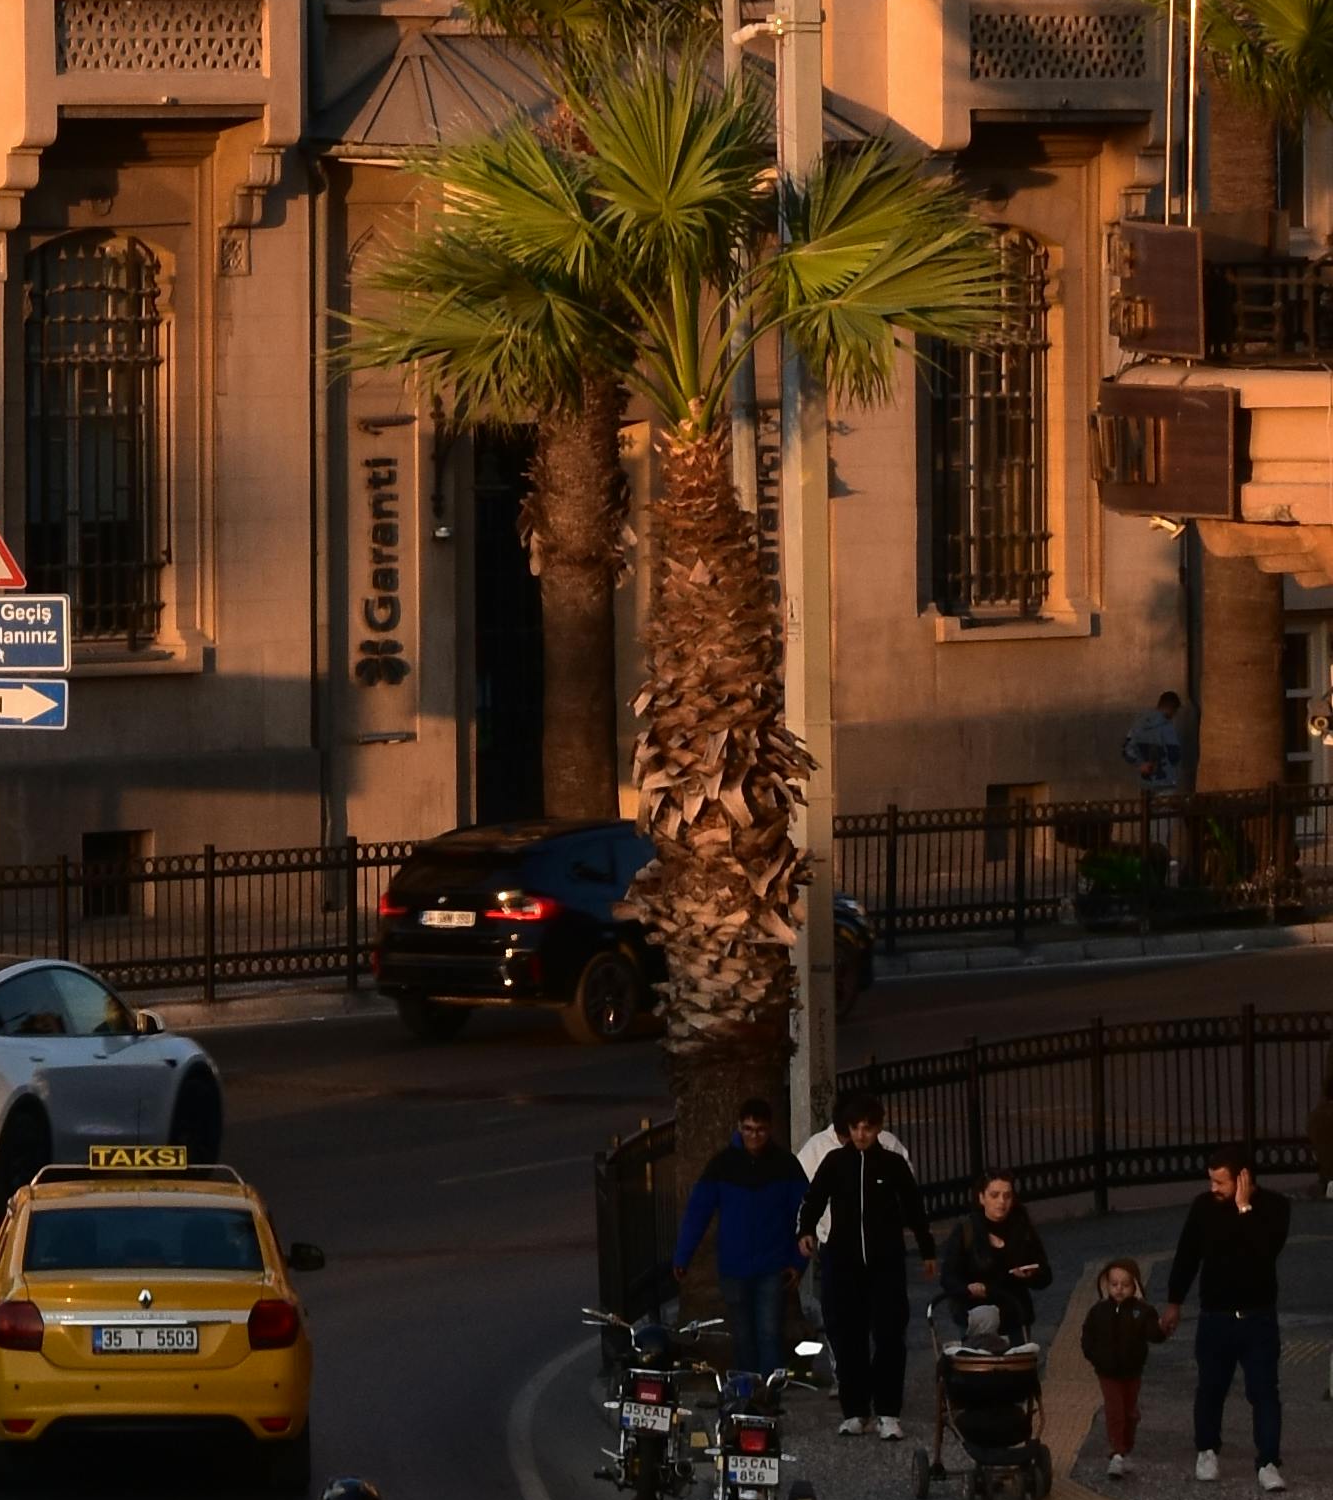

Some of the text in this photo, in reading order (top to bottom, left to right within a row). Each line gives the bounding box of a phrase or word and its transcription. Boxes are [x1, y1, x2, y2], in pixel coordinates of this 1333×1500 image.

[362, 457, 401, 632] Garanti
[0, 603, 52, 625] Geçiş
[103, 1330, 194, 1346] 35 T 5503
[625, 1404, 668, 1418] 35 CAL
[731, 1457, 776, 1470] 35 CAL
[739, 1471, 765, 1482] 856
